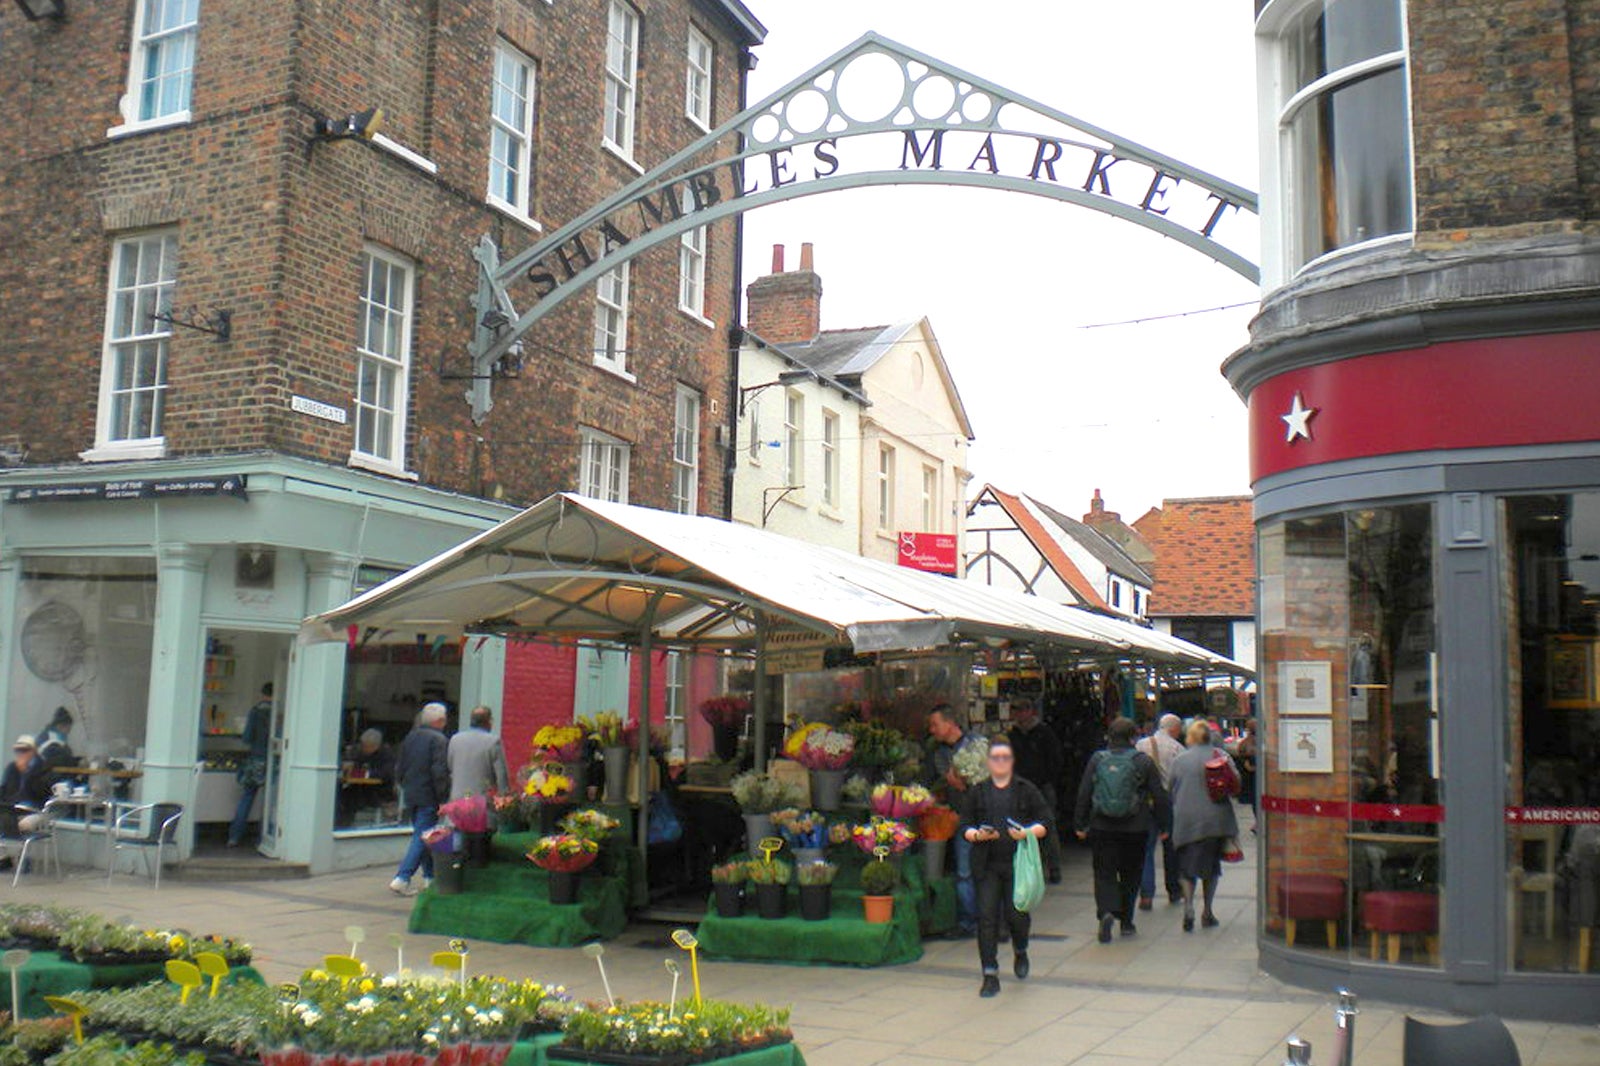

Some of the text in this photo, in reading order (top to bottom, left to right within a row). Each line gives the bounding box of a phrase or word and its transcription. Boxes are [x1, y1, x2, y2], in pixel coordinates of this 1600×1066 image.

[527, 128, 1244, 299] SHAMBLES MARKET
[1522, 810, 1600, 822] AMERICANO
